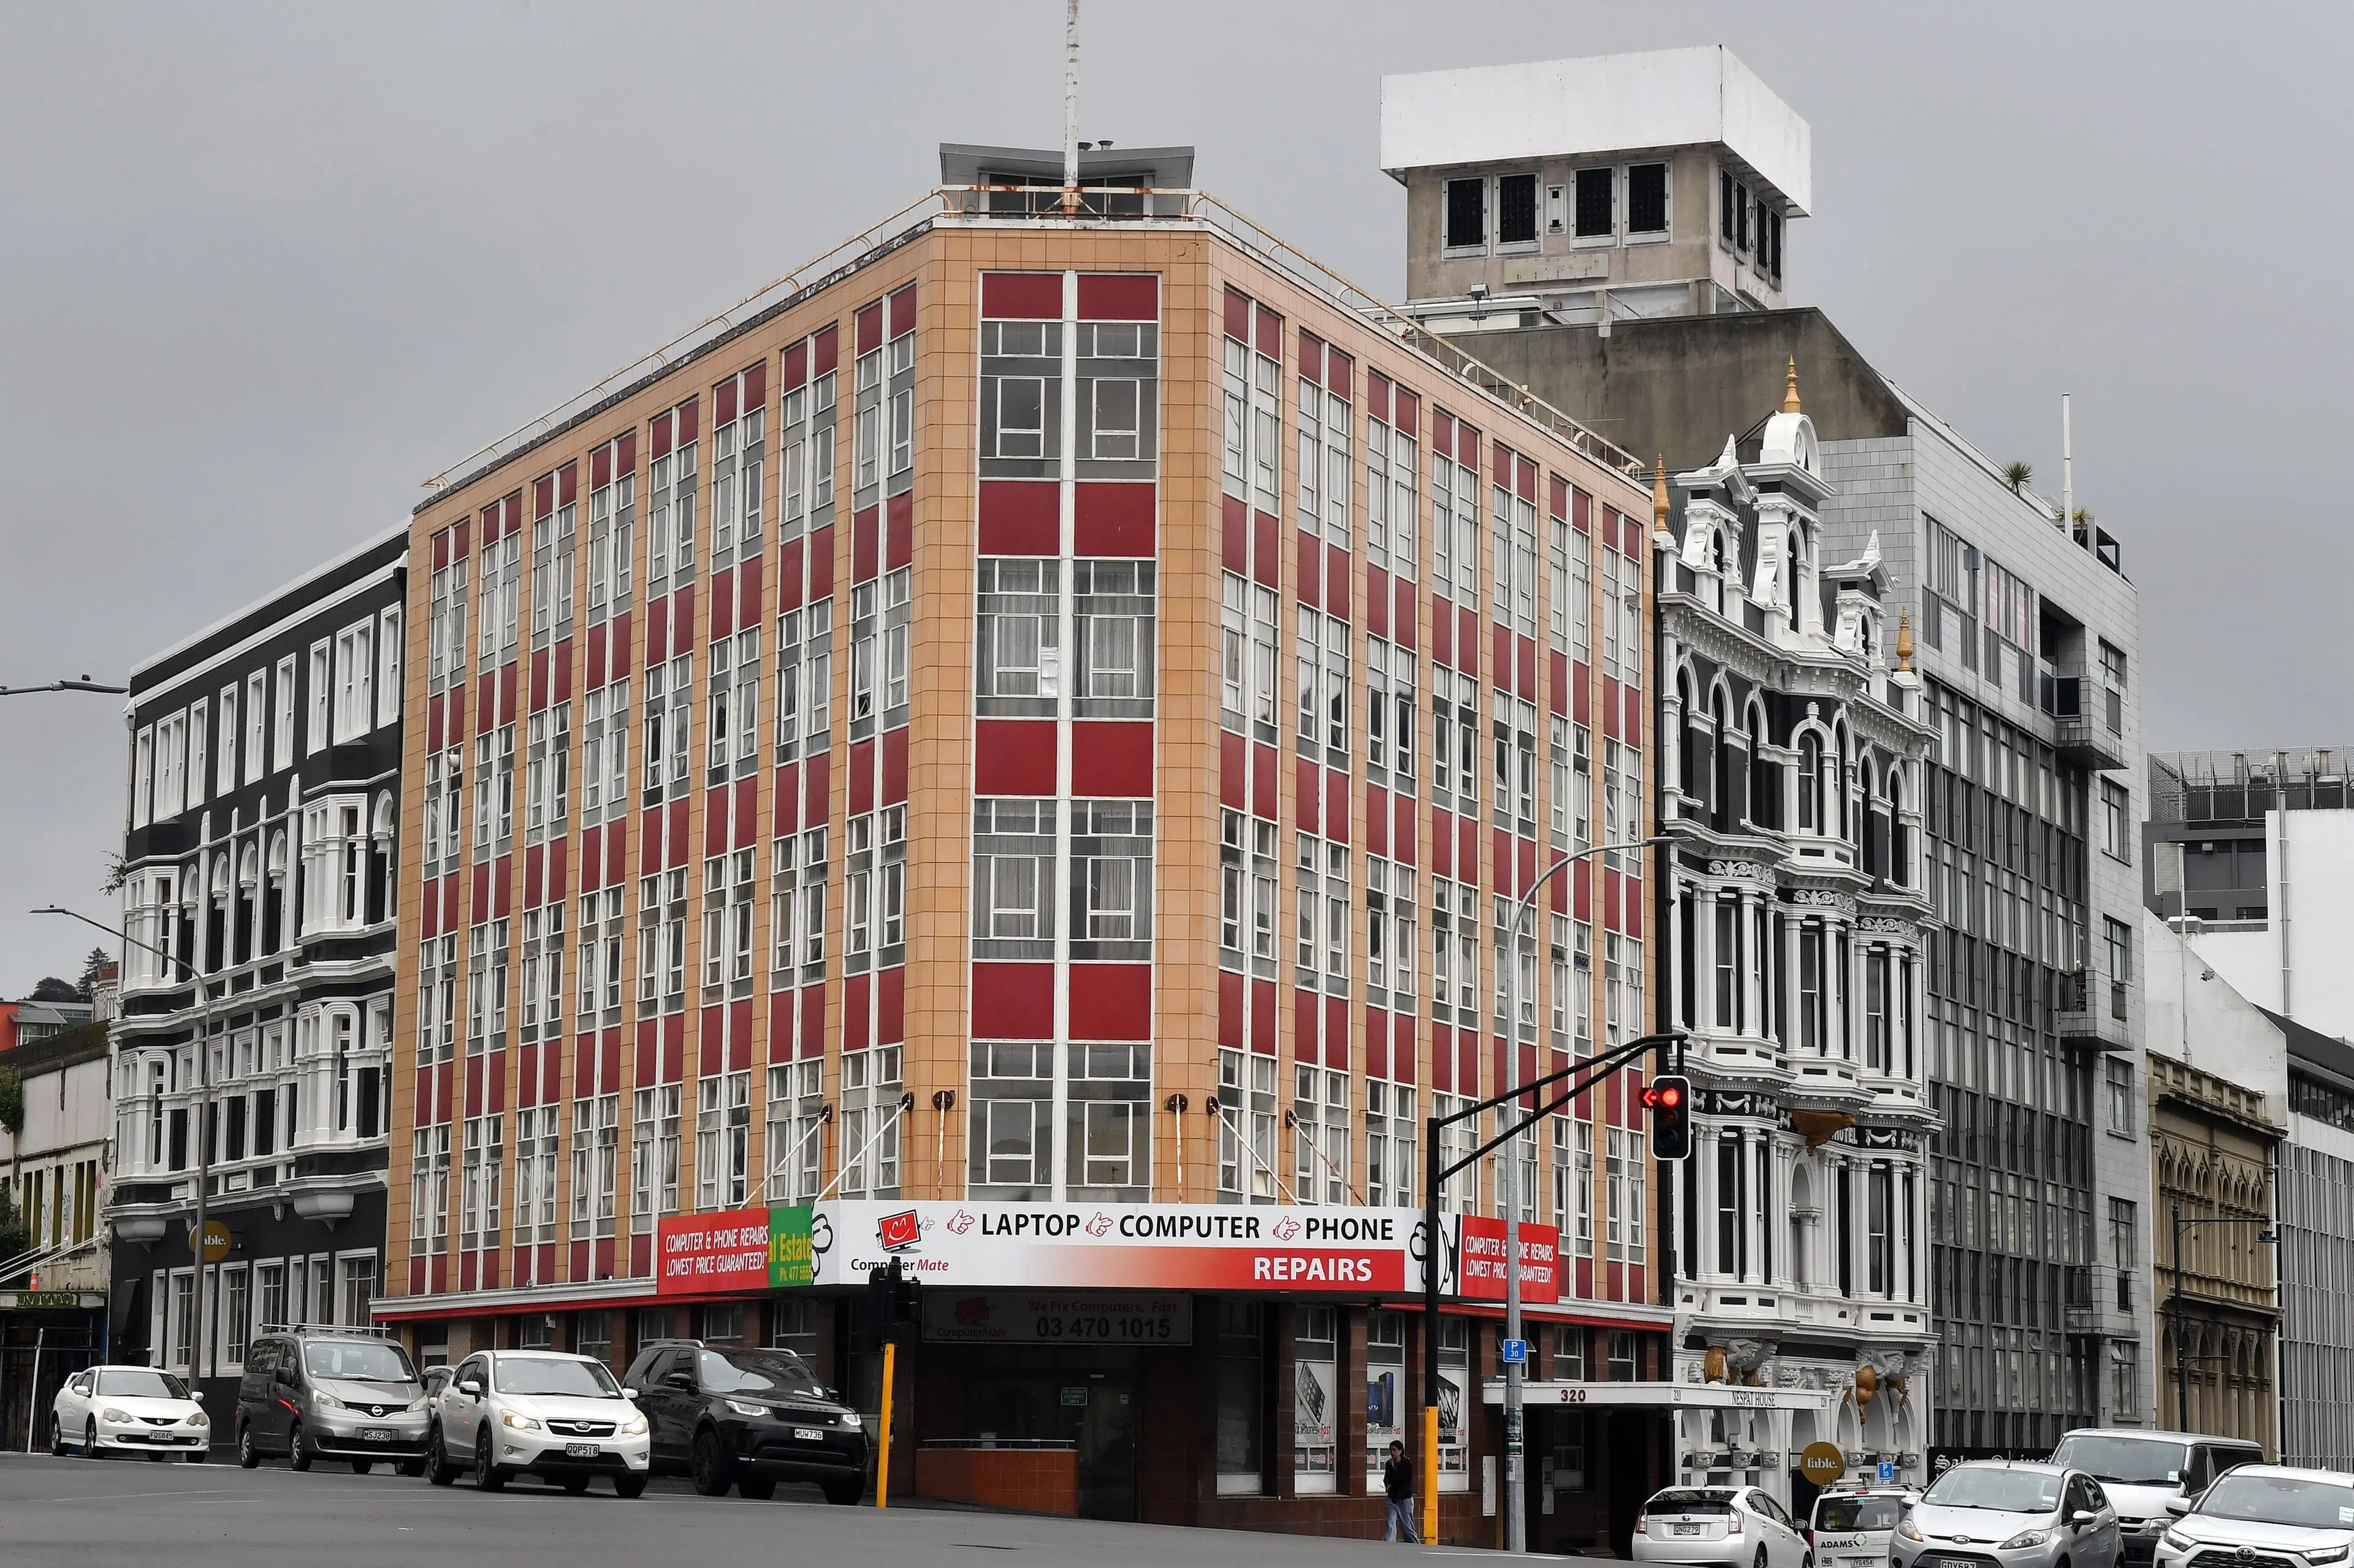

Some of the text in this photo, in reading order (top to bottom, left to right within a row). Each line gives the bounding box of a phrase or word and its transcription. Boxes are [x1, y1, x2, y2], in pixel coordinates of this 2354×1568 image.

[982, 1213, 1393, 1241] LAPTOP COMPUTER PHONE
[666, 1225, 769, 1254] COMPUTER & PHONE REPAIRS
[780, 1232, 812, 1262] Estate
[1465, 1235, 1499, 1257] COMPUTER
[1531, 1243, 1553, 1262] REPAIRS
[666, 1257, 694, 1277] LOWEST
[695, 1255, 714, 1275] PRICE
[917, 1259, 950, 1271] Mate
[1254, 1257, 1373, 1282] REPAIRS
[1466, 1259, 1491, 1278] LOWEST
[1051, 1301, 1068, 1312] Fix
[1072, 1300, 1145, 1314] Computers,
[1152, 1301, 1178, 1312] Fast
[1036, 1317, 1171, 1338] 03 470 1015
[1561, 1389, 1586, 1402] 320
[1732, 1391, 1775, 1407] NESPAT HOUSE
[796, 1429, 822, 1439] MUW736
[568, 1445, 598, 1455] QQP518
[1807, 1456, 1838, 1469] fable.
[1821, 1540, 1853, 1549] ADAMS
